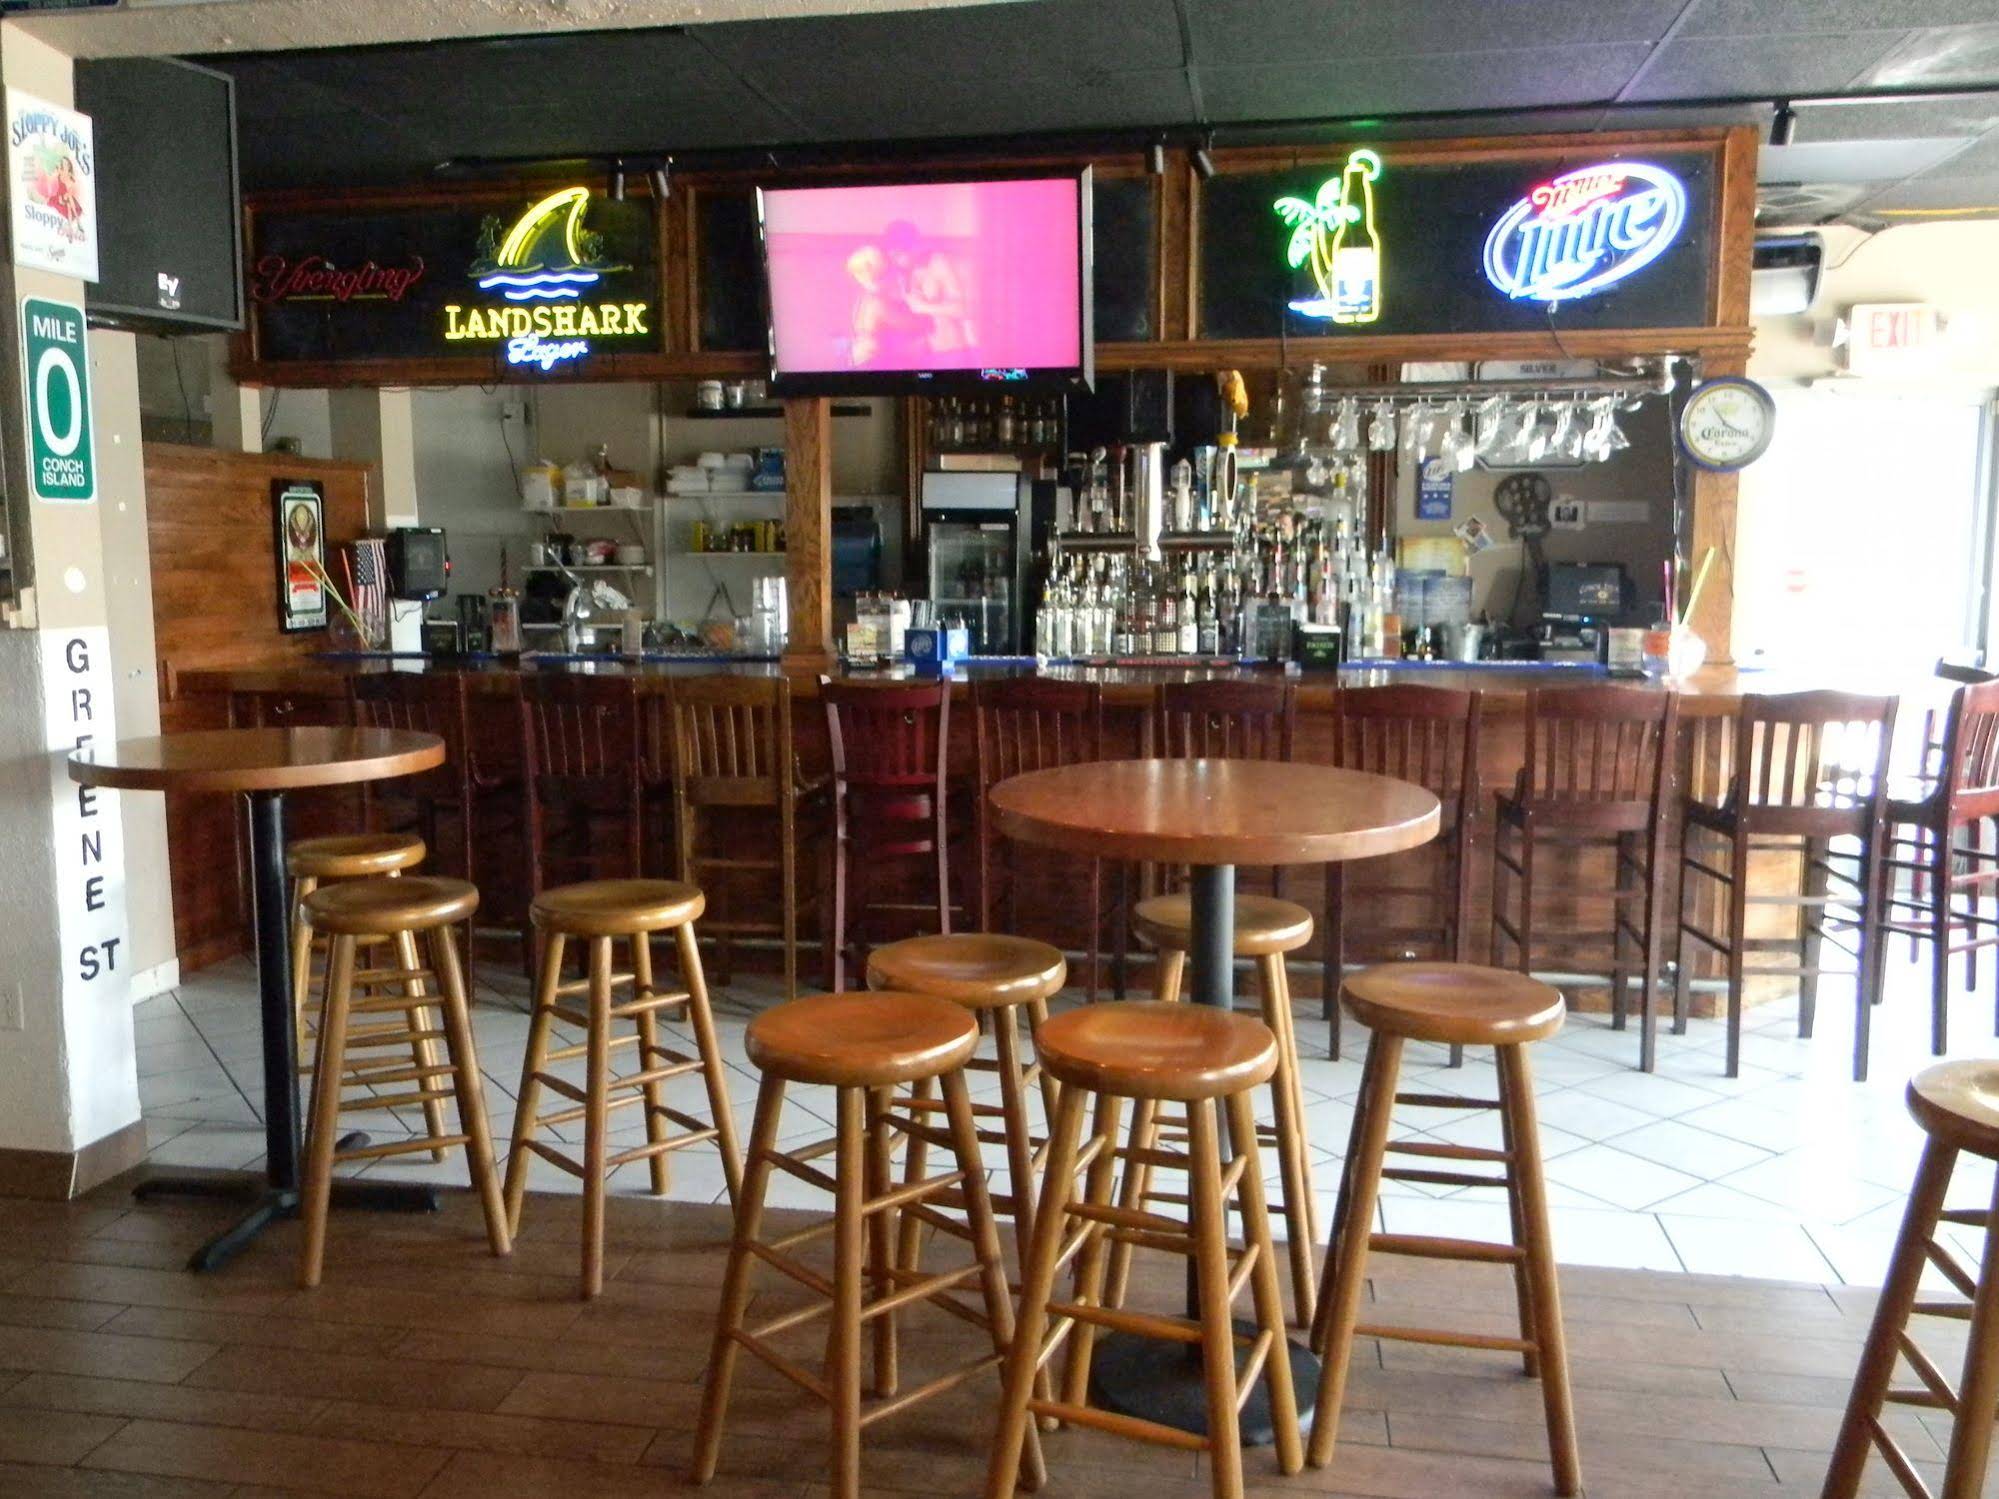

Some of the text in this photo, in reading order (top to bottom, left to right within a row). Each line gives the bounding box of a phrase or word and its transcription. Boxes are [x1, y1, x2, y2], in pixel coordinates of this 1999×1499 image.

[12, 111, 59, 147] SLOPPY
[60, 125, 90, 176] JOE'S
[25, 204, 65, 229] Sloppy
[1508, 188, 1666, 301] Lite
[253, 255, 425, 303] Yuengling
[33, 315, 77, 343] MILE
[444, 303, 649, 340] LANDSHARK
[1871, 311, 1924, 348] EXIT
[507, 333, 588, 371] Lager
[36, 347, 82, 456] 0
[1700, 426, 1750, 441] Corona
[42, 456, 84, 474] CONCH
[42, 471, 86, 488] ISLAND
[80, 937, 120, 981] ST
